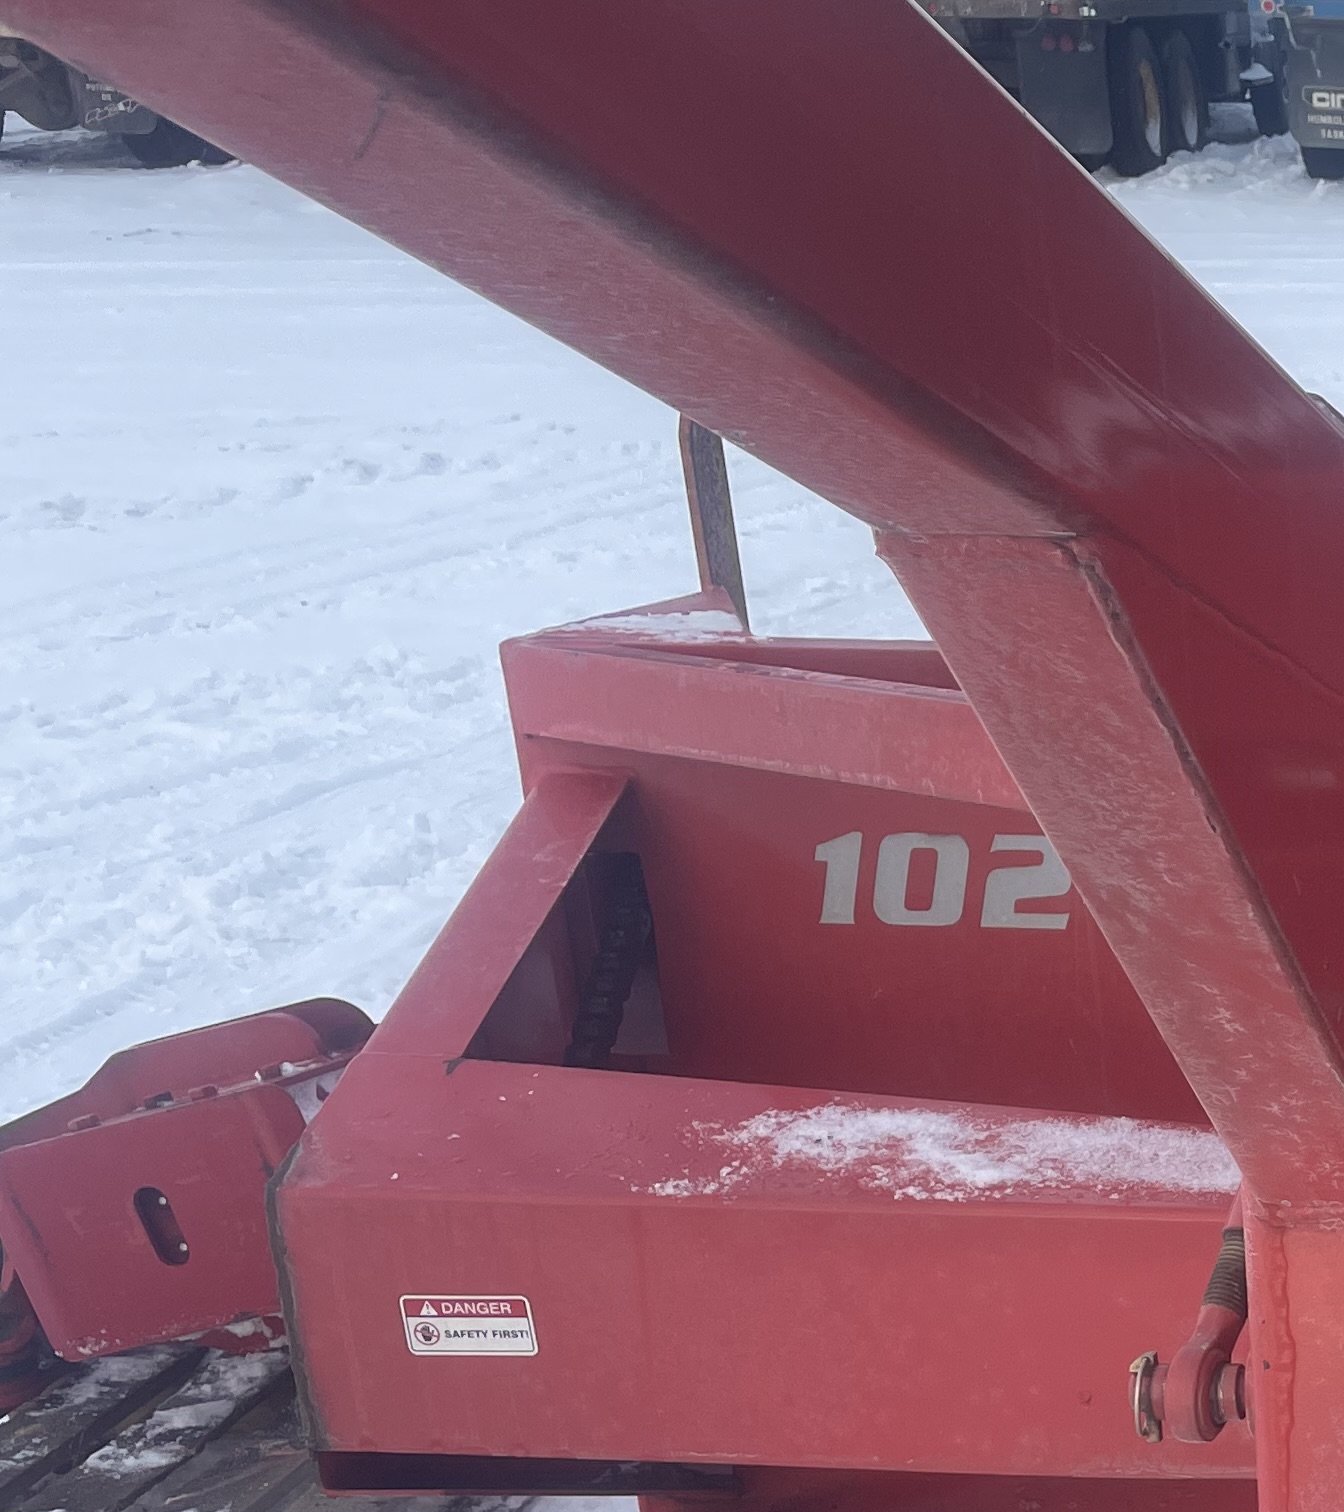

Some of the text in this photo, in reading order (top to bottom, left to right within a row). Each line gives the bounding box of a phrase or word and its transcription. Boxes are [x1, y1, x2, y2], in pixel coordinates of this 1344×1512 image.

[814, 831, 1073, 930] 102
[440, 1301, 512, 1315] DANGER
[444, 1329, 530, 1340] SAFETY FIRST!
